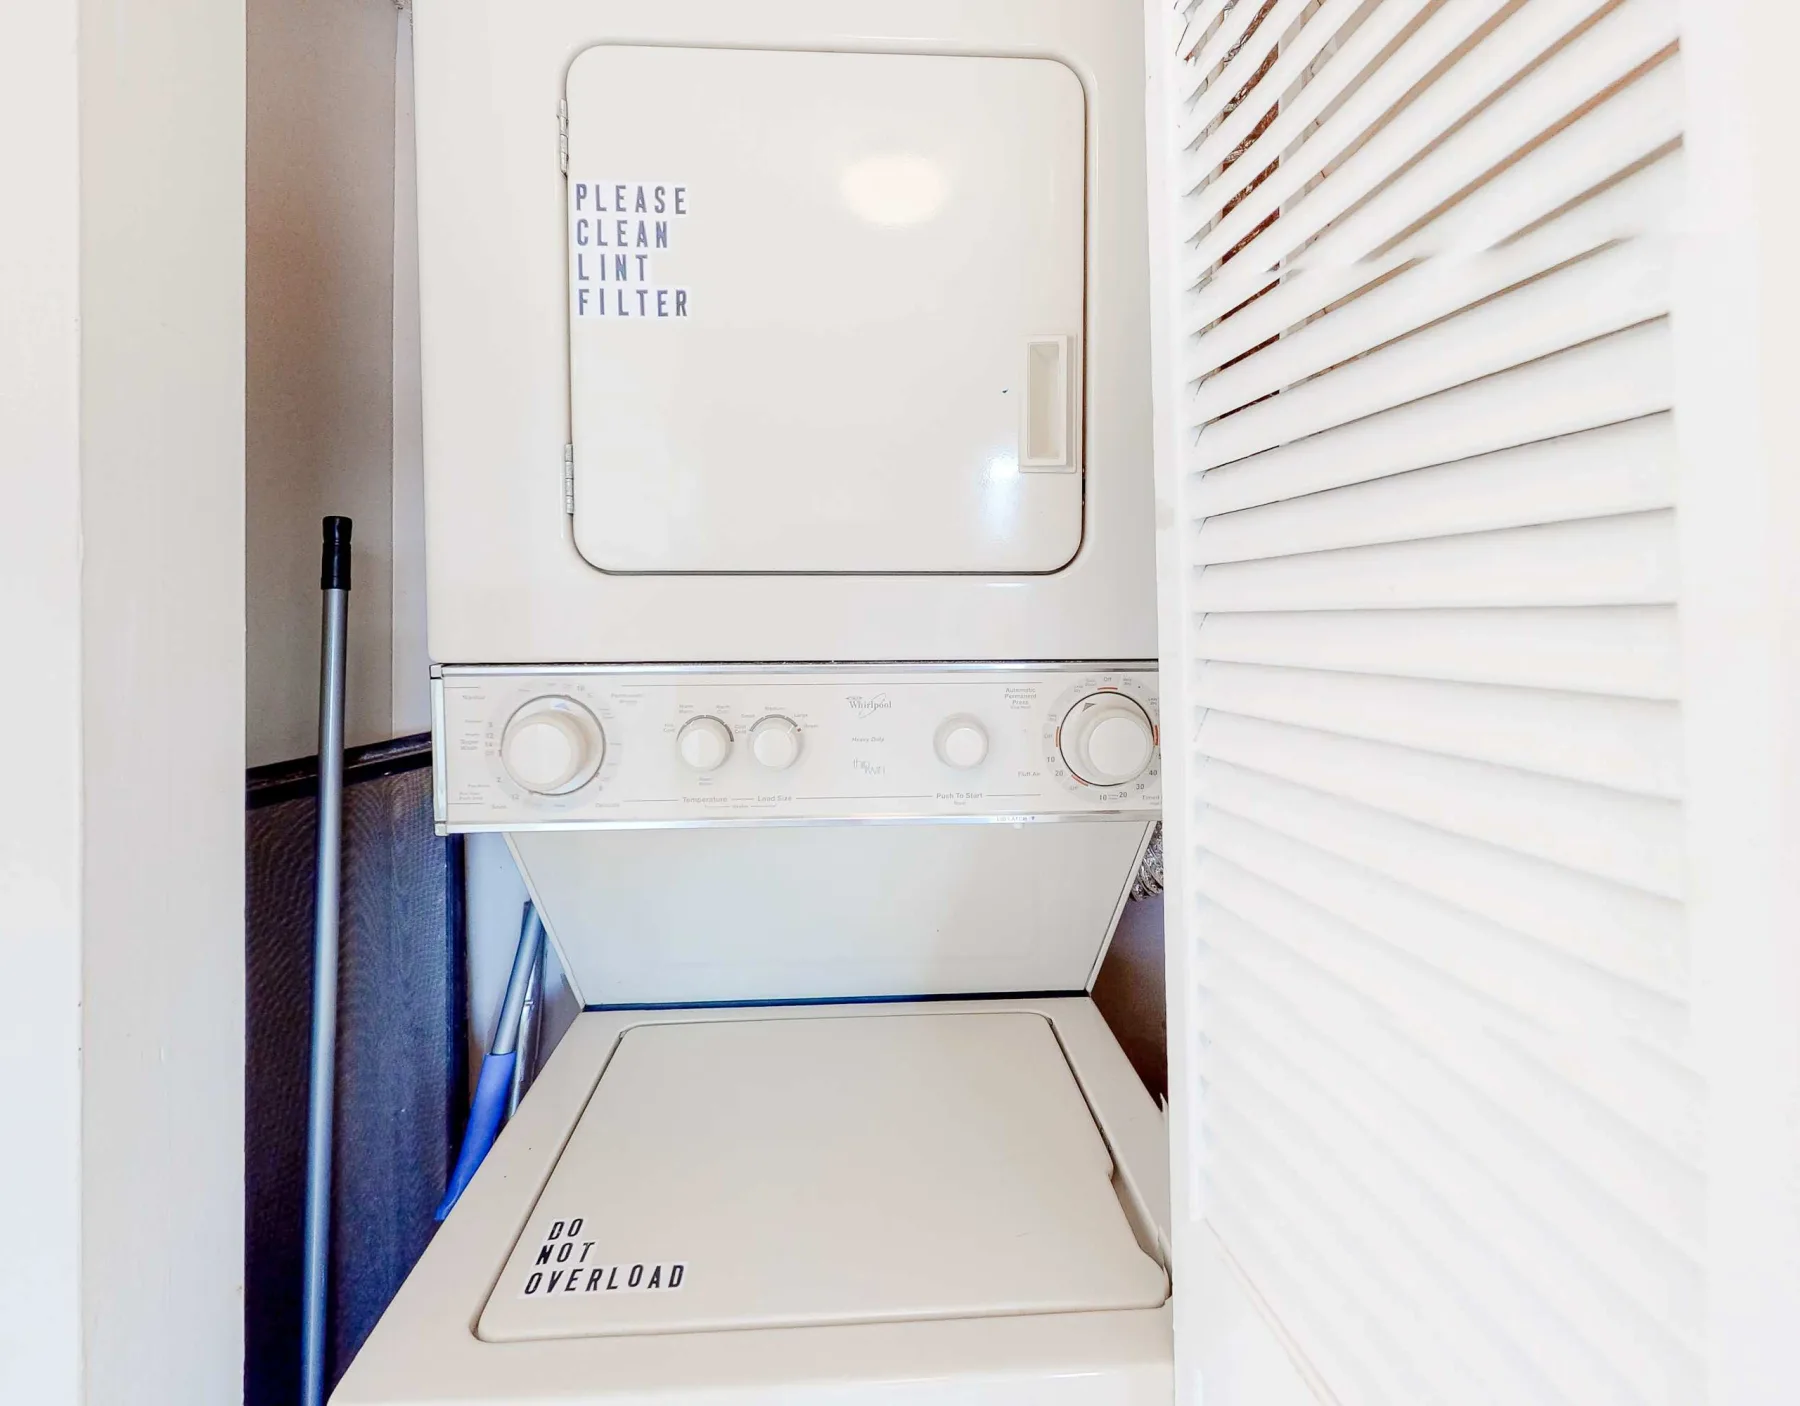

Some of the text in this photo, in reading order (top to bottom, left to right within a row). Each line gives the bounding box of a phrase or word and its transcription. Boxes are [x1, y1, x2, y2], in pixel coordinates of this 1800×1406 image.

[576, 183, 687, 215] PLEASE
[577, 218, 667, 248] CLEAN
[578, 253, 648, 281] LINT
[579, 288, 687, 317] FILTER
[849, 700, 892, 711] Whirlpool
[548, 1218, 584, 1241] DO
[535, 1241, 596, 1266] NOT
[524, 1264, 684, 1295] OVERLOAD
